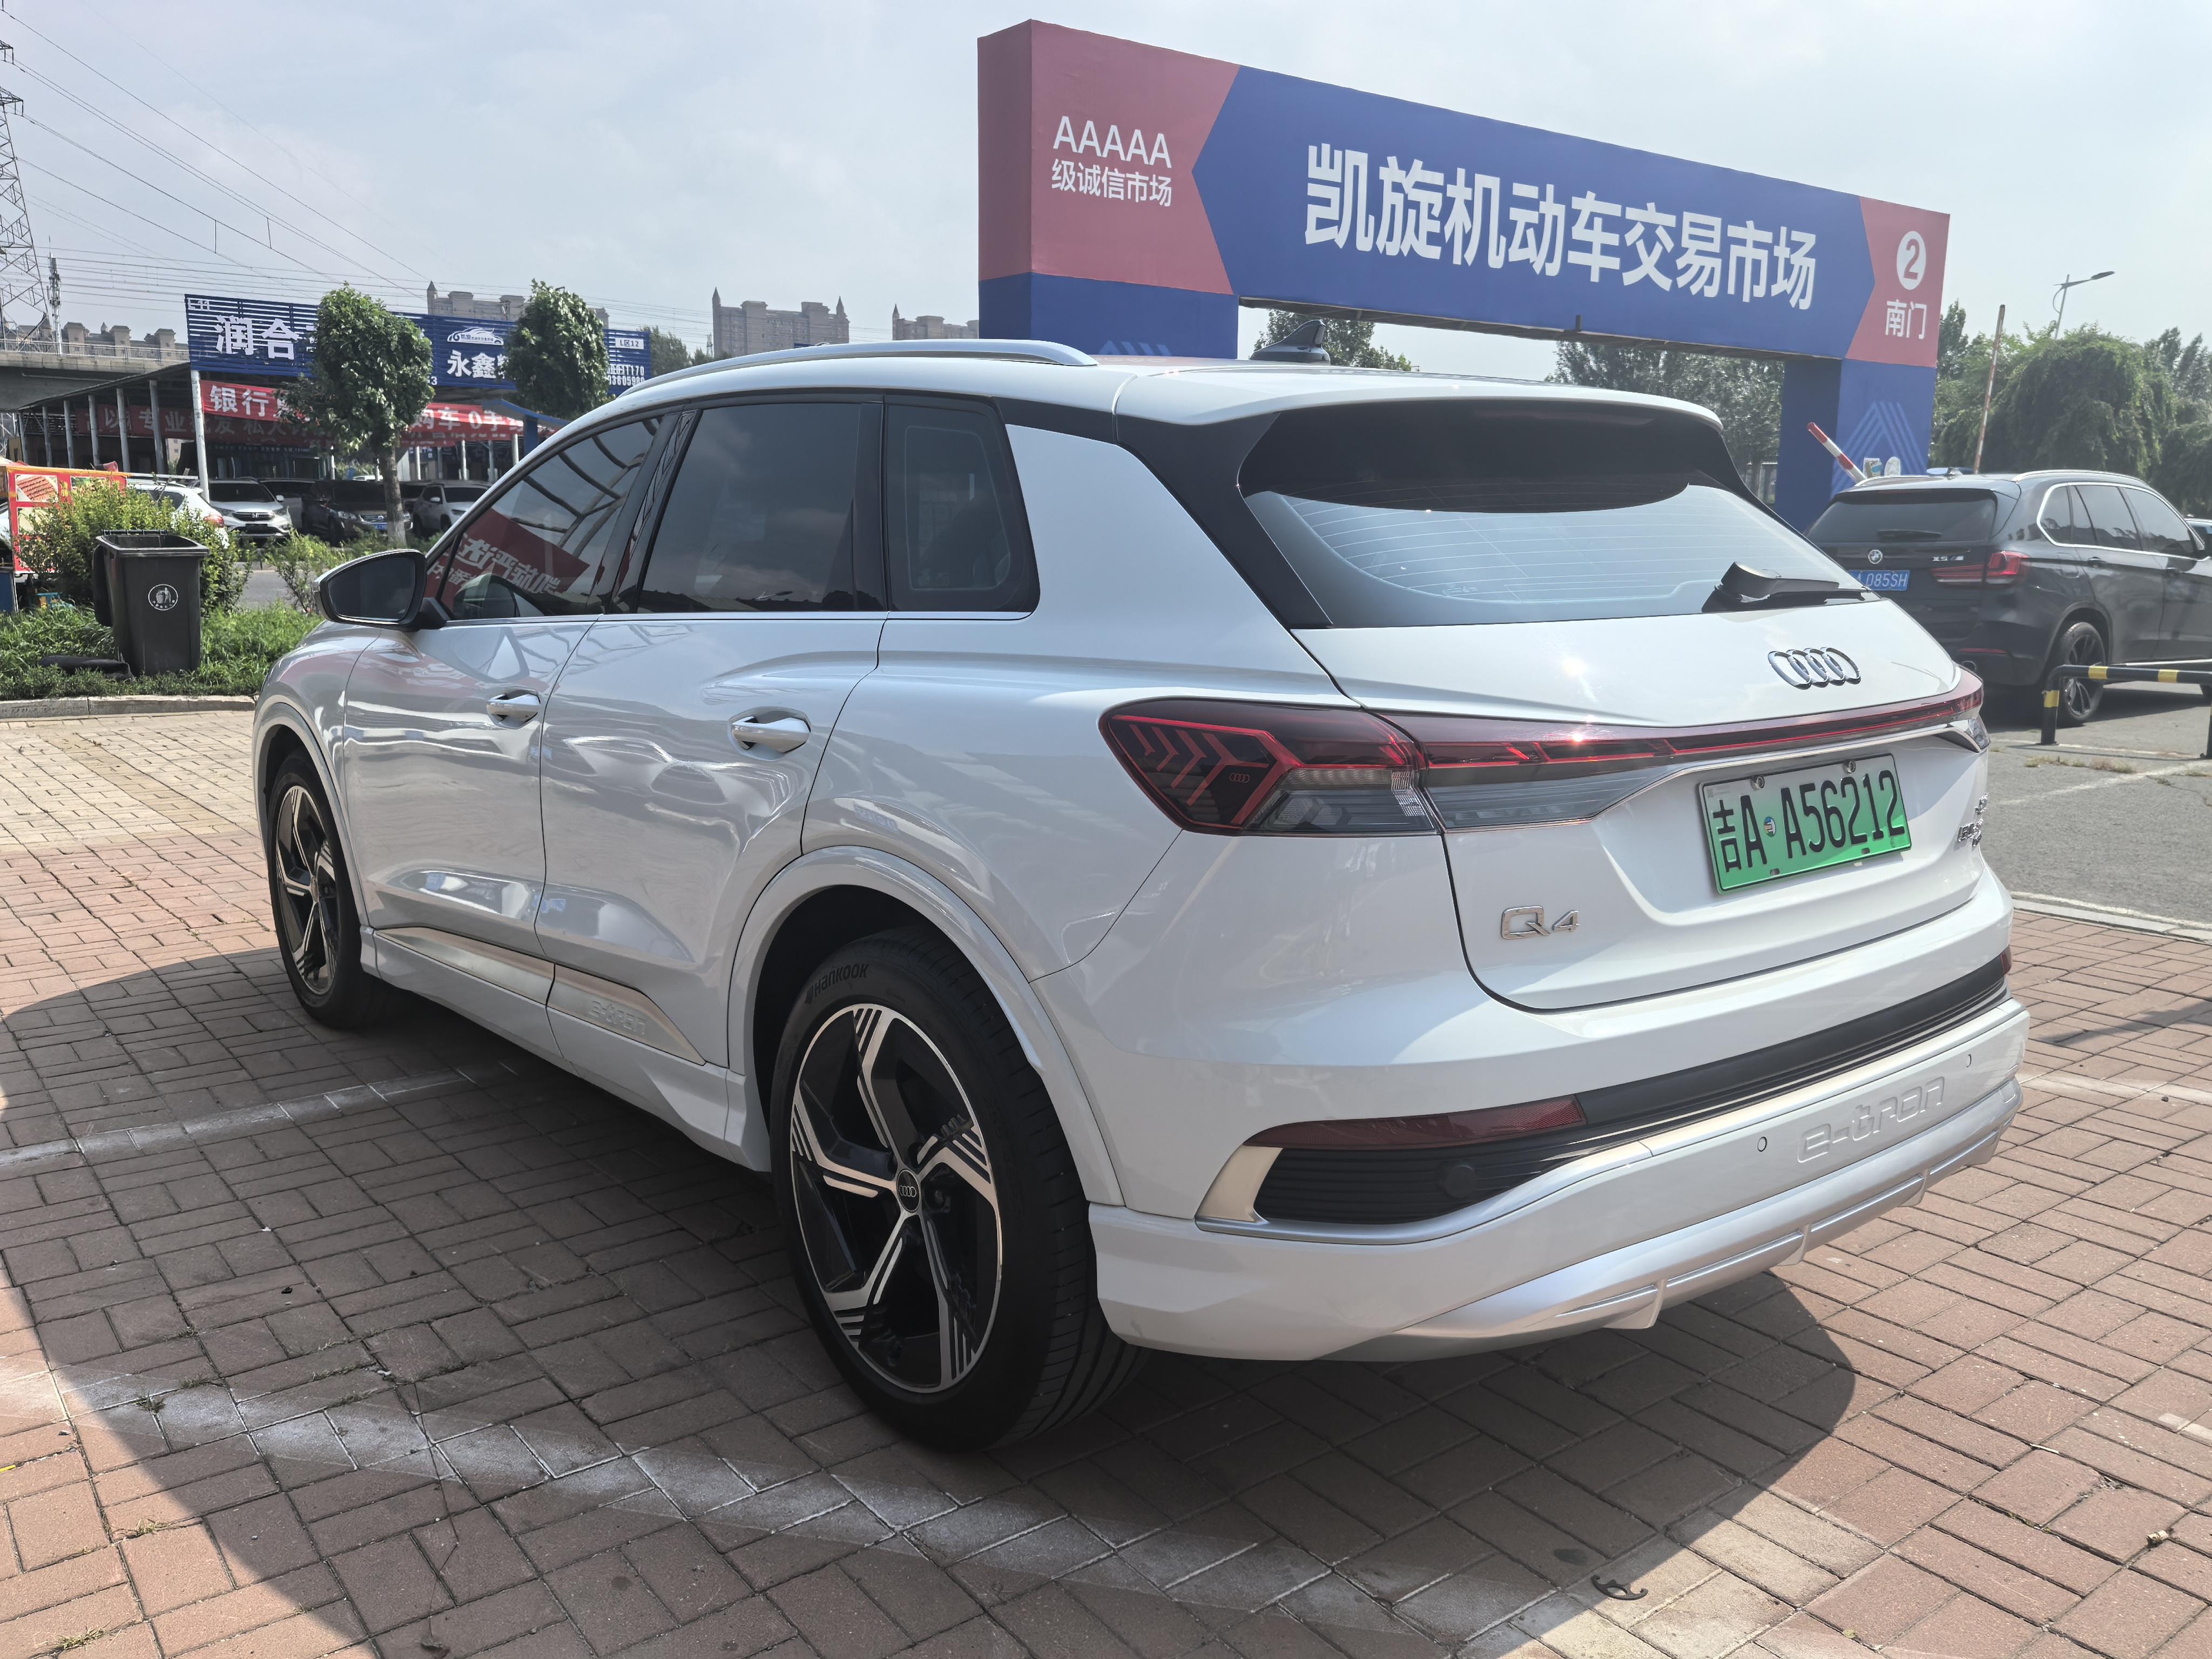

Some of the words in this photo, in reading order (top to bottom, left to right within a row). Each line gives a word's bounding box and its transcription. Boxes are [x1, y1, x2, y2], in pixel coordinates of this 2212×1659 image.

[1053, 115, 1172, 169] AAAAA
[1051, 158, 1172, 207] 级诚信市场
[1304, 142, 1817, 310] 凯旋机动车交易市场
[1903, 238, 1920, 280] 2
[214, 315, 318, 360] 润合
[1885, 298, 1927, 340] 南门
[447, 349, 509, 380] 永鑫
[619, 339, 640, 347] L区12
[1712, 794, 1768, 873] 吉A
[1780, 770, 1906, 859] A56212
[1500, 905, 1580, 940] Q4
[1797, 1076, 1945, 1164] e-tron
